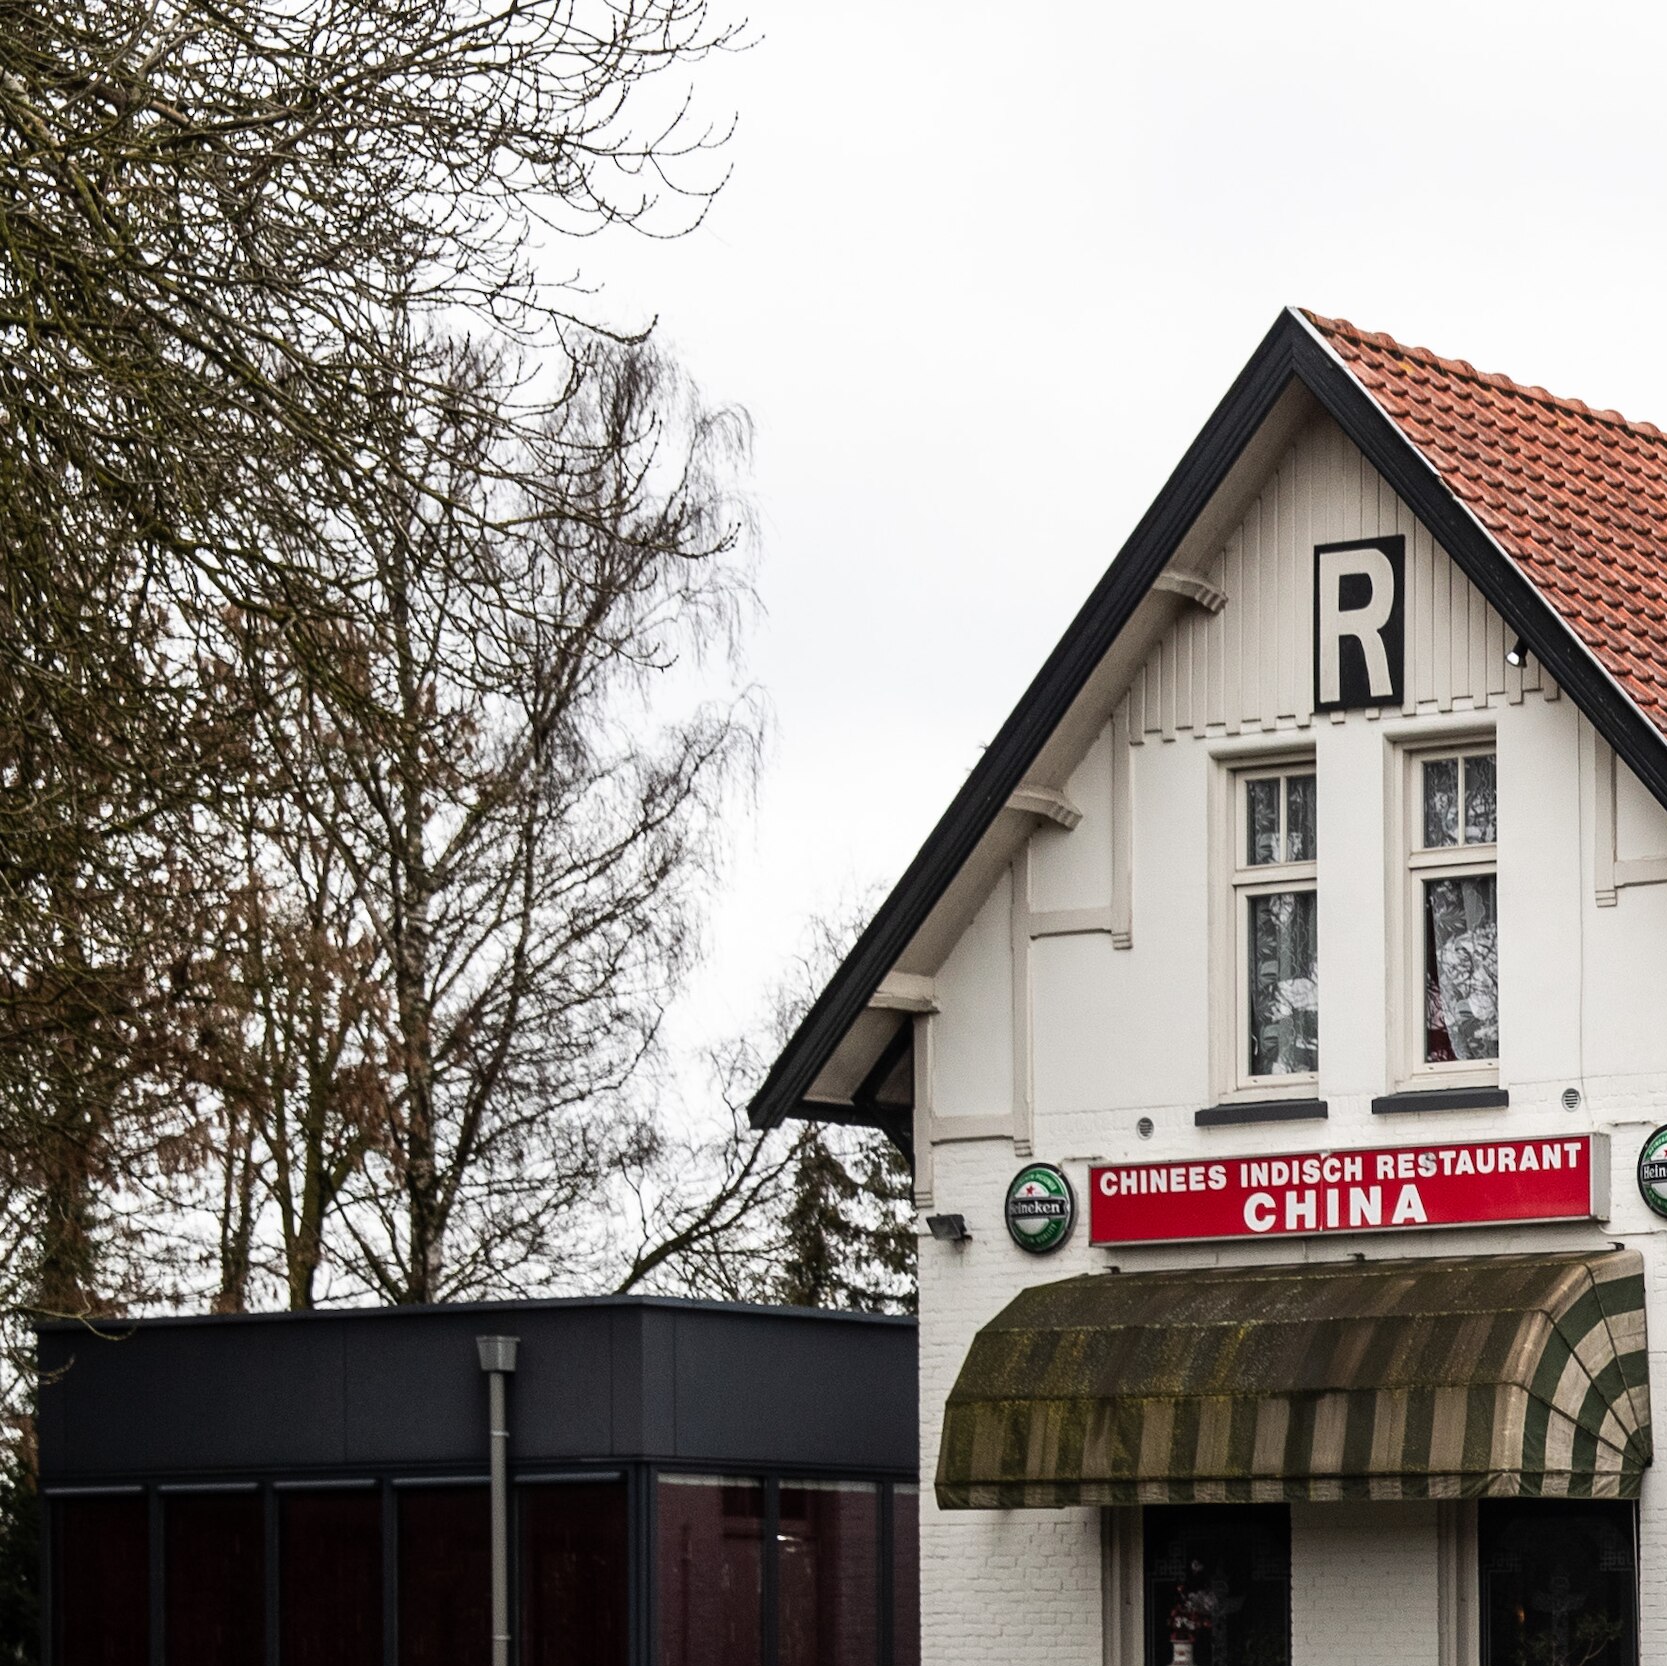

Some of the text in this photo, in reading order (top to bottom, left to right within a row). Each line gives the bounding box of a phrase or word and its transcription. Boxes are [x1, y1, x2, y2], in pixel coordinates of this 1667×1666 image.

[1319, 548, 1394, 703] R
[1100, 1142, 1581, 1196] CHINEES INDISCH RESTAURANT
[1243, 1183, 1428, 1232] CHINA
